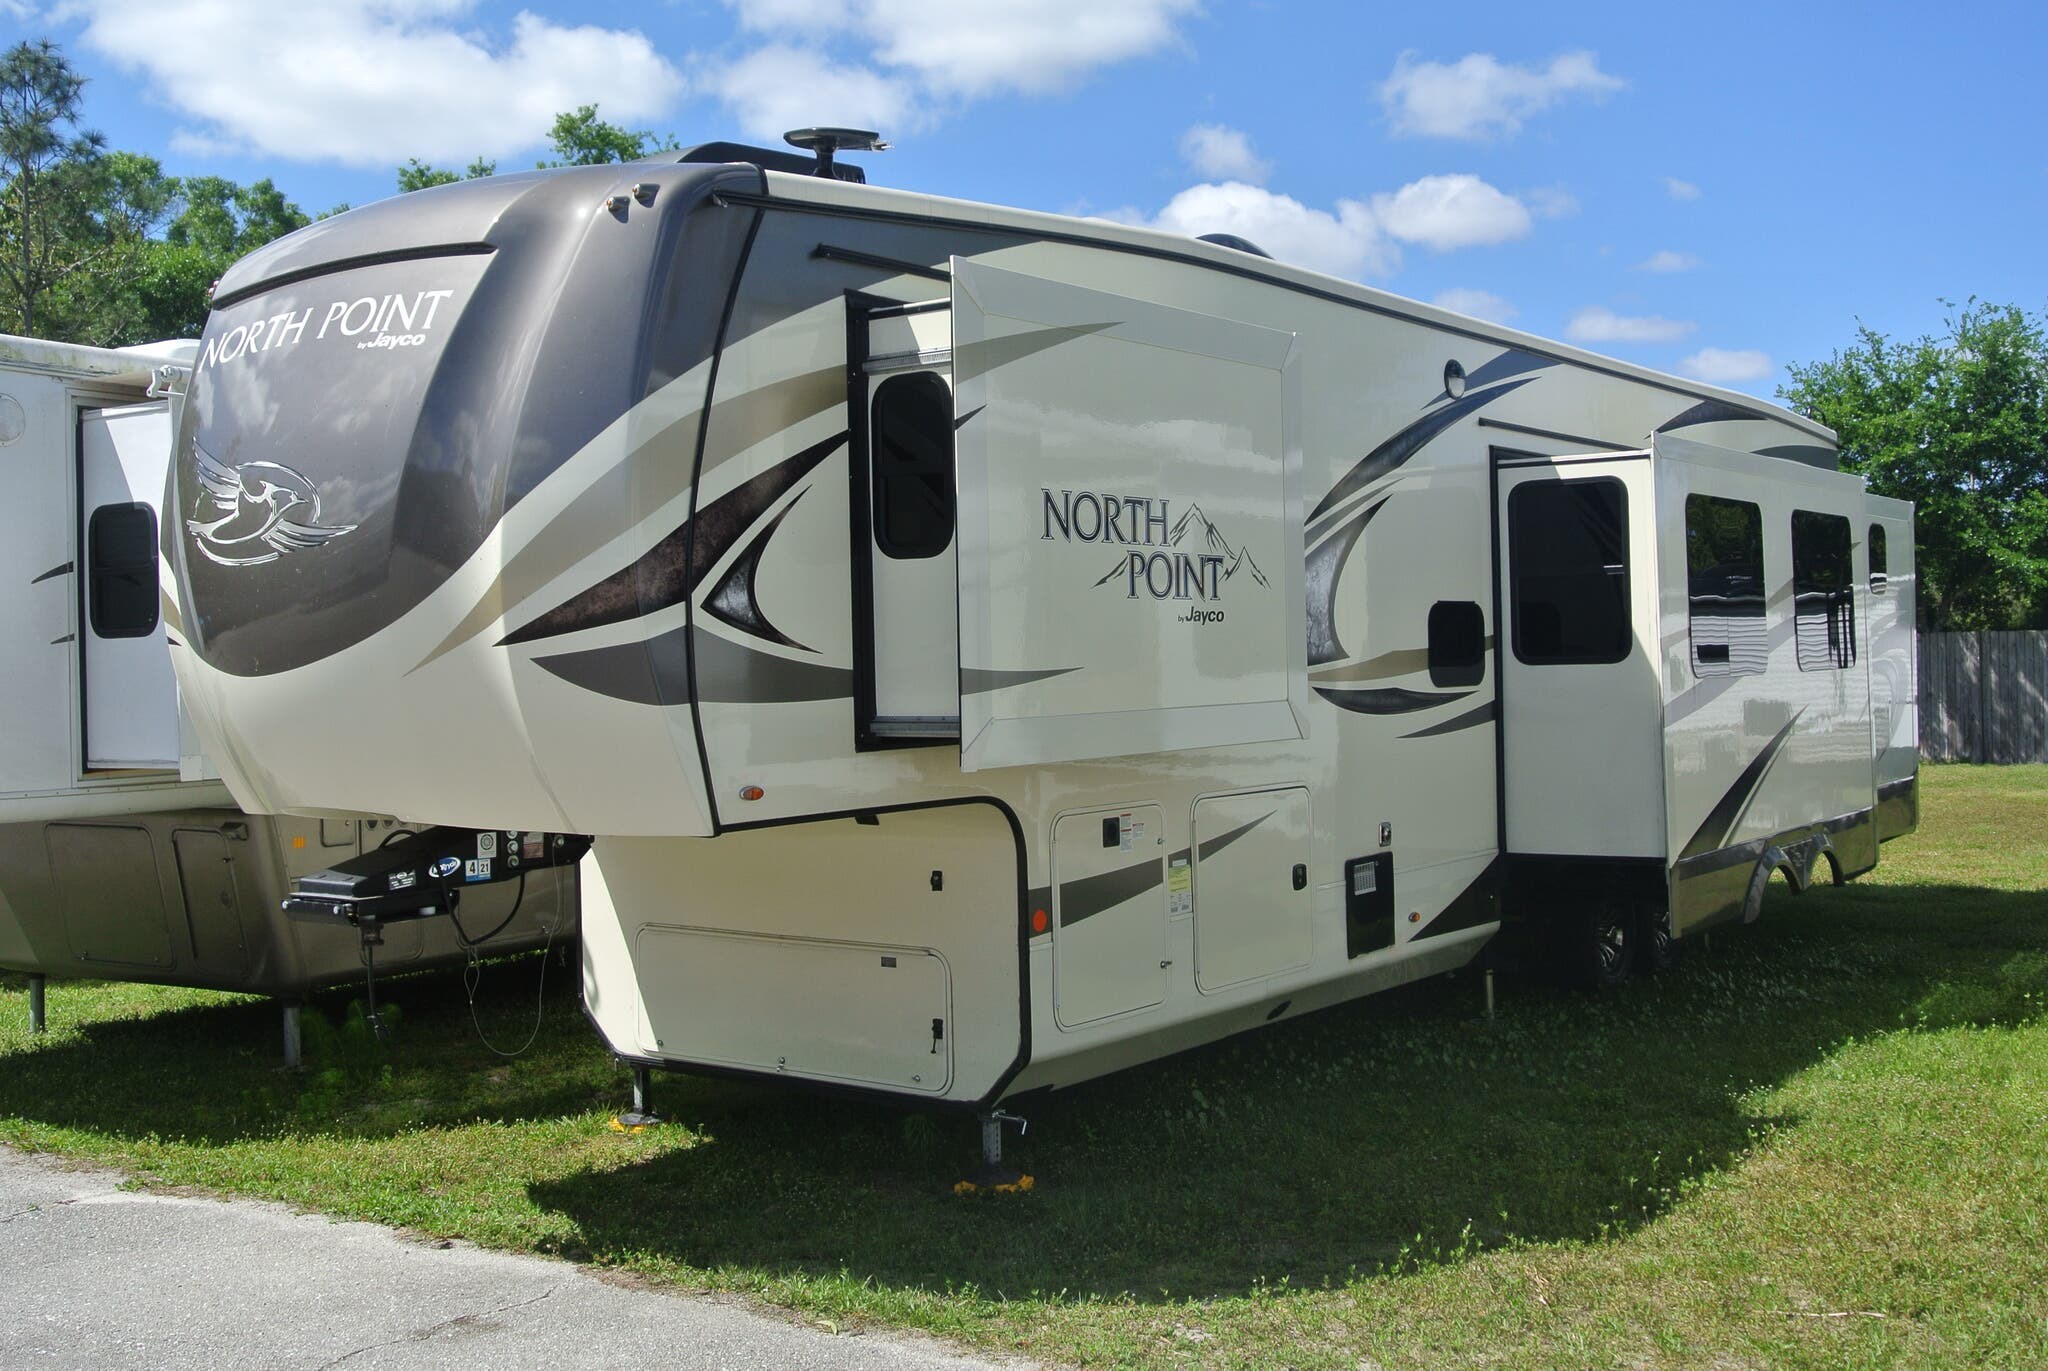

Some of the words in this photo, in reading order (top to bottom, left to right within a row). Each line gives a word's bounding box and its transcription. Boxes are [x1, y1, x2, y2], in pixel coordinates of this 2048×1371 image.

[198, 307, 313, 373] NORTH
[317, 290, 453, 340] POINT
[367, 332, 426, 350] Jayco
[1040, 488, 1171, 547] NORTH
[1127, 550, 1225, 602] POINT
[1177, 615, 1185, 623] by
[1185, 606, 1225, 626] Jayco
[469, 861, 476, 874] 4
[480, 863, 489, 873] 21
